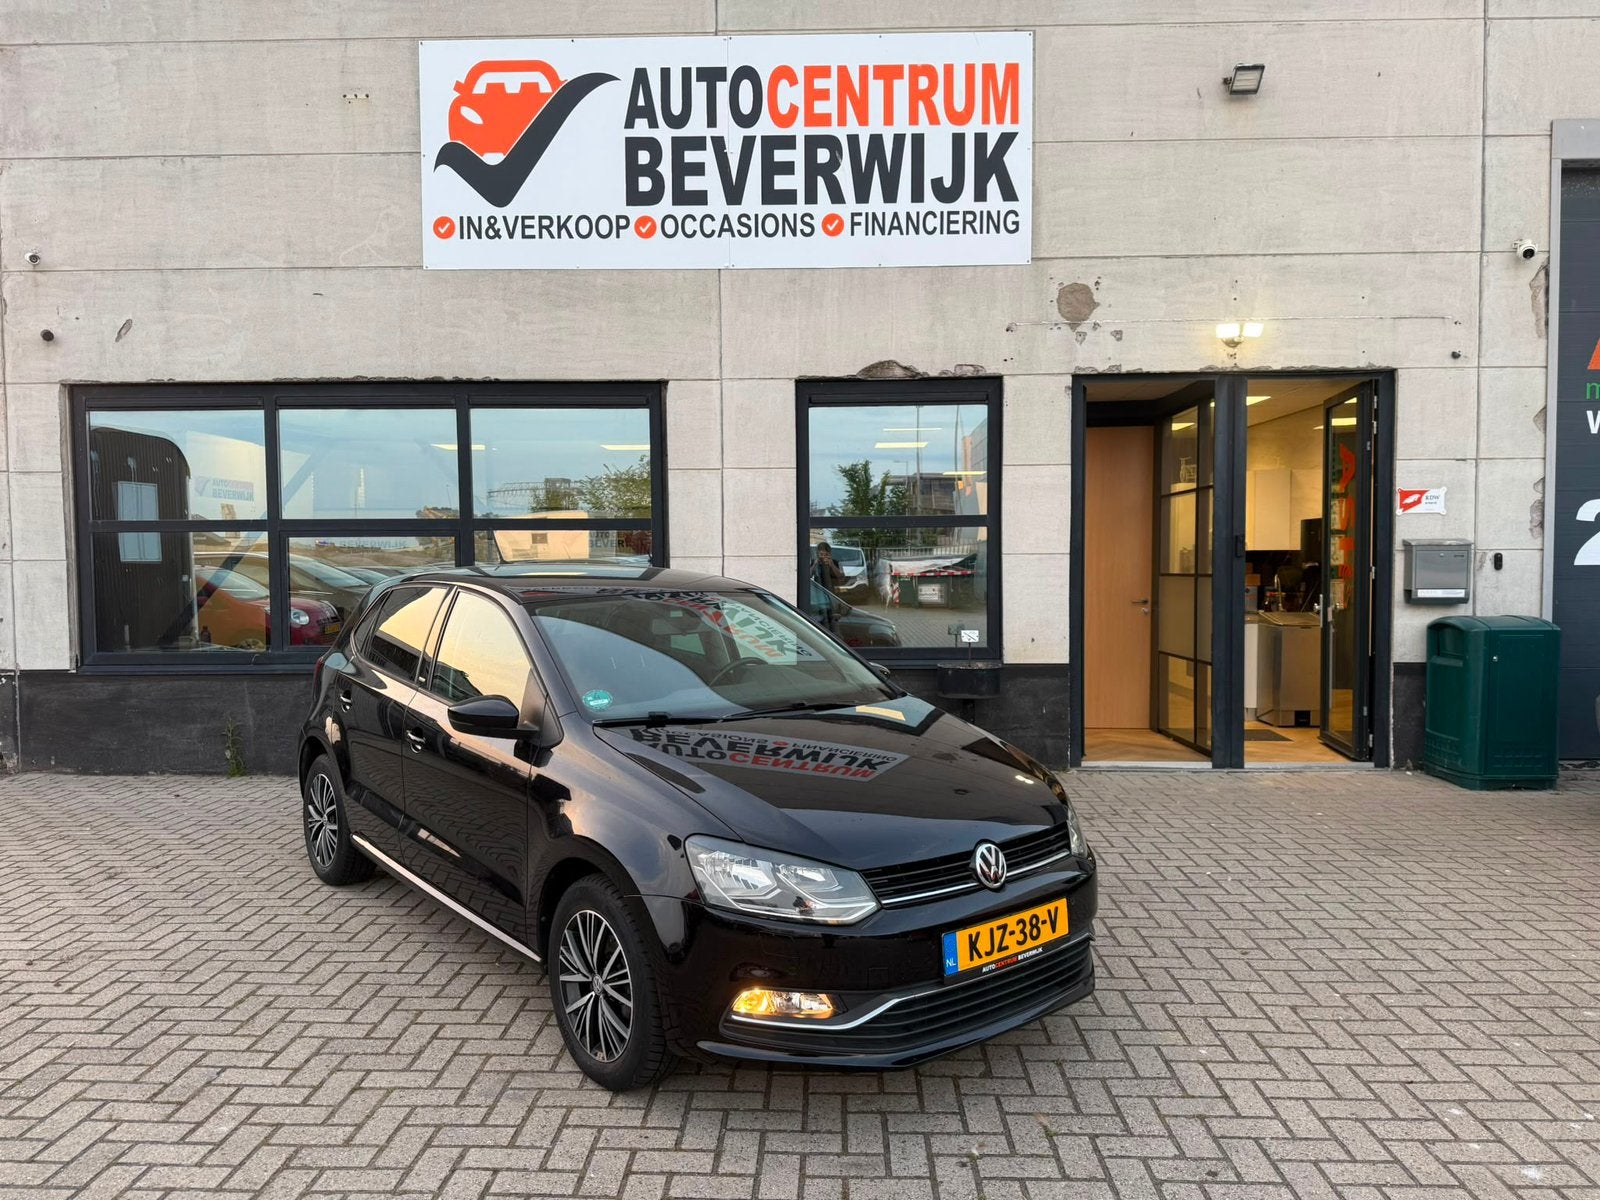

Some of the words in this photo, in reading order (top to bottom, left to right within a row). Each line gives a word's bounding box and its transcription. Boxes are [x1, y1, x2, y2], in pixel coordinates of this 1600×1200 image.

[624, 62, 1020, 130] AUTOCENTRUM
[624, 131, 1019, 207] BEVERWIJK
[458, 214, 631, 240] IN&VERKOOP
[660, 212, 816, 239] OCCASIONS
[850, 209, 1020, 237] FINANCIERING
[968, 905, 1059, 962] KJZ-38-V
[945, 957, 957, 968] NL
